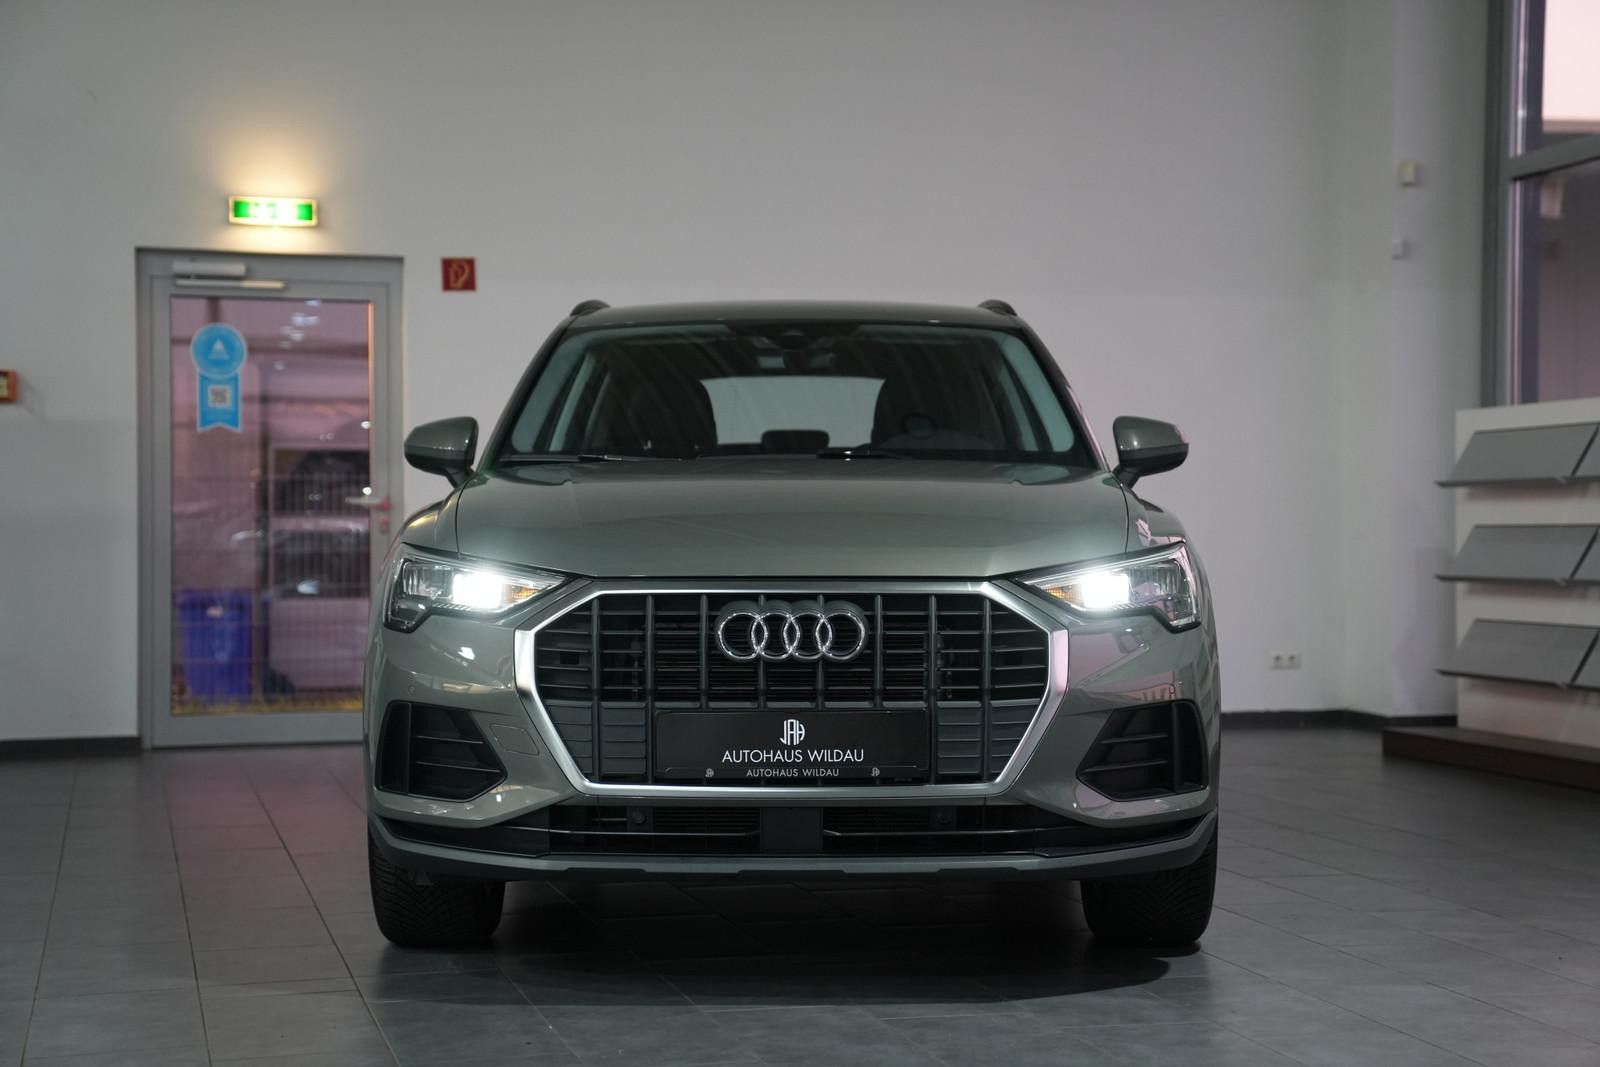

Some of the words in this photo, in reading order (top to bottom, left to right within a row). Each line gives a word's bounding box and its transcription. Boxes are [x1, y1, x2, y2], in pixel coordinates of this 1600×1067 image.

[721, 748, 803, 763] AUTOHAUS
[807, 748, 864, 762] WILDAU
[745, 768, 799, 777] AUTOHAUS
[802, 768, 840, 777] WILDAU
